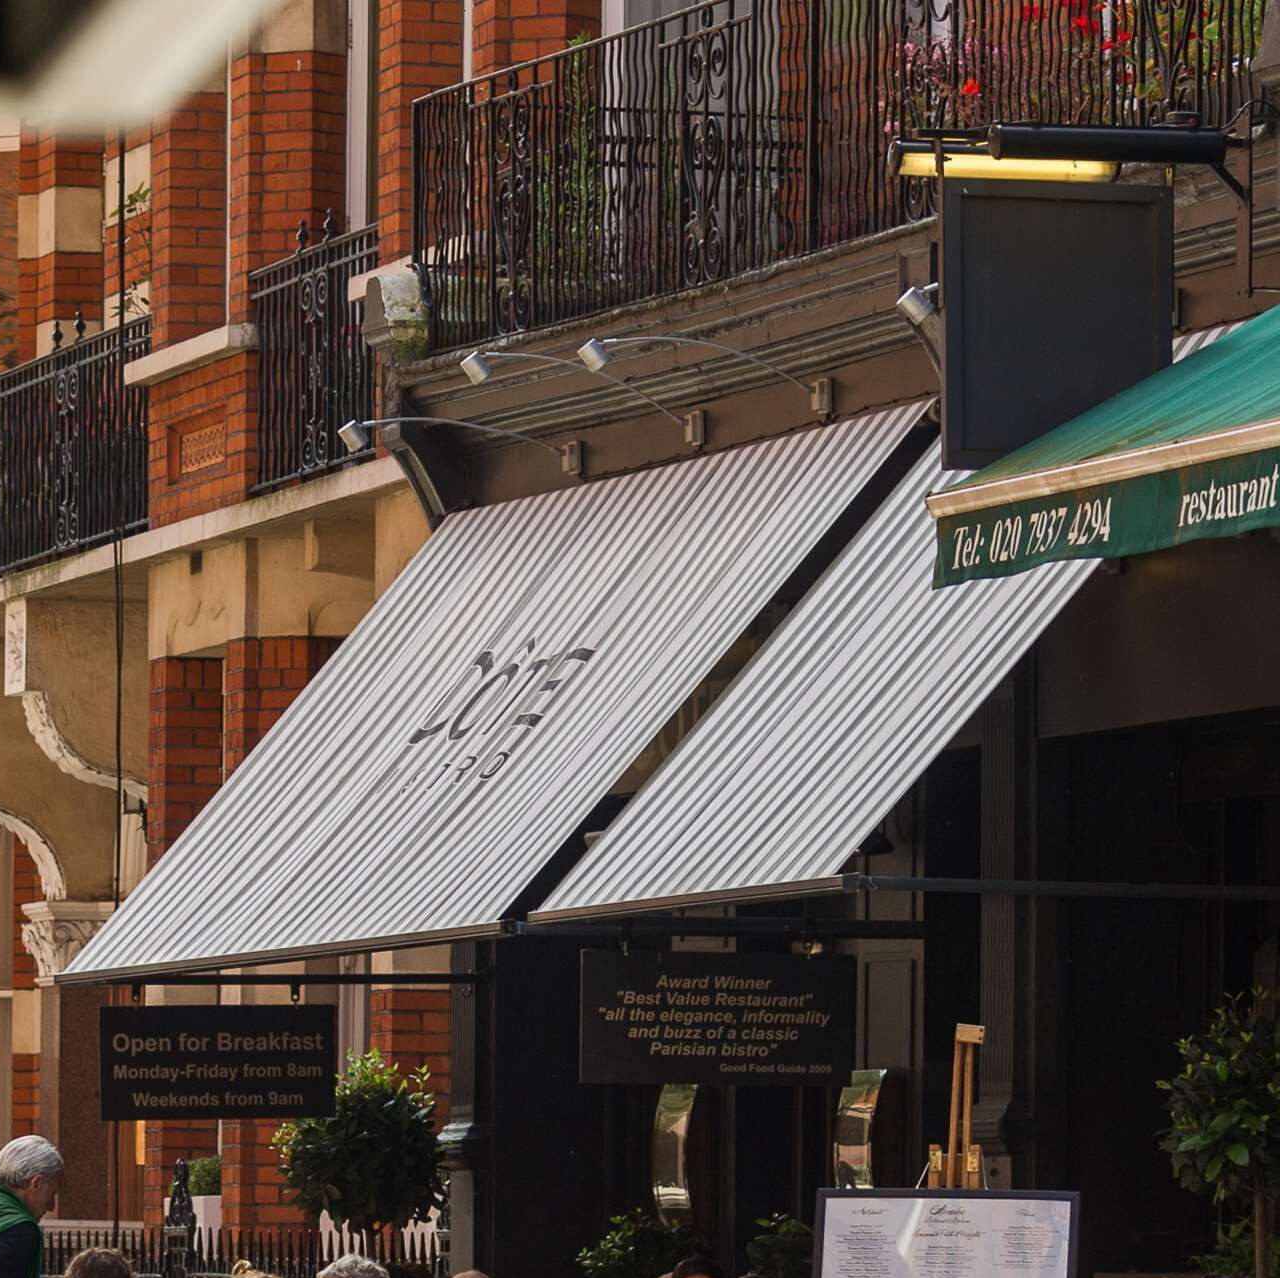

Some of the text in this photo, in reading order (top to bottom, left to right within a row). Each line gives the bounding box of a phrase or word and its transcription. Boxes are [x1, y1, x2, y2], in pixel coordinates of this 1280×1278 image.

[1177, 463, 1279, 528] restaurant
[952, 497, 1112, 571] Tel: 020 7937 4294
[656, 975, 772, 990] Award Winner
[617, 991, 814, 1007] "Best Value Restaurant"
[599, 1007, 831, 1028] "all the elegance, informality
[628, 1025, 800, 1041] and buzz of a classic
[112, 1032, 323, 1056] Open for Breakfast
[650, 1042, 778, 1057] Parisian bistro"
[113, 1063, 322, 1082] Monday-Friday from 8am
[720, 1063, 747, 1073] Good
[749, 1063, 772, 1073] Food
[777, 1064, 806, 1074] Guide
[132, 1091, 304, 1107] Weekends from 9am
